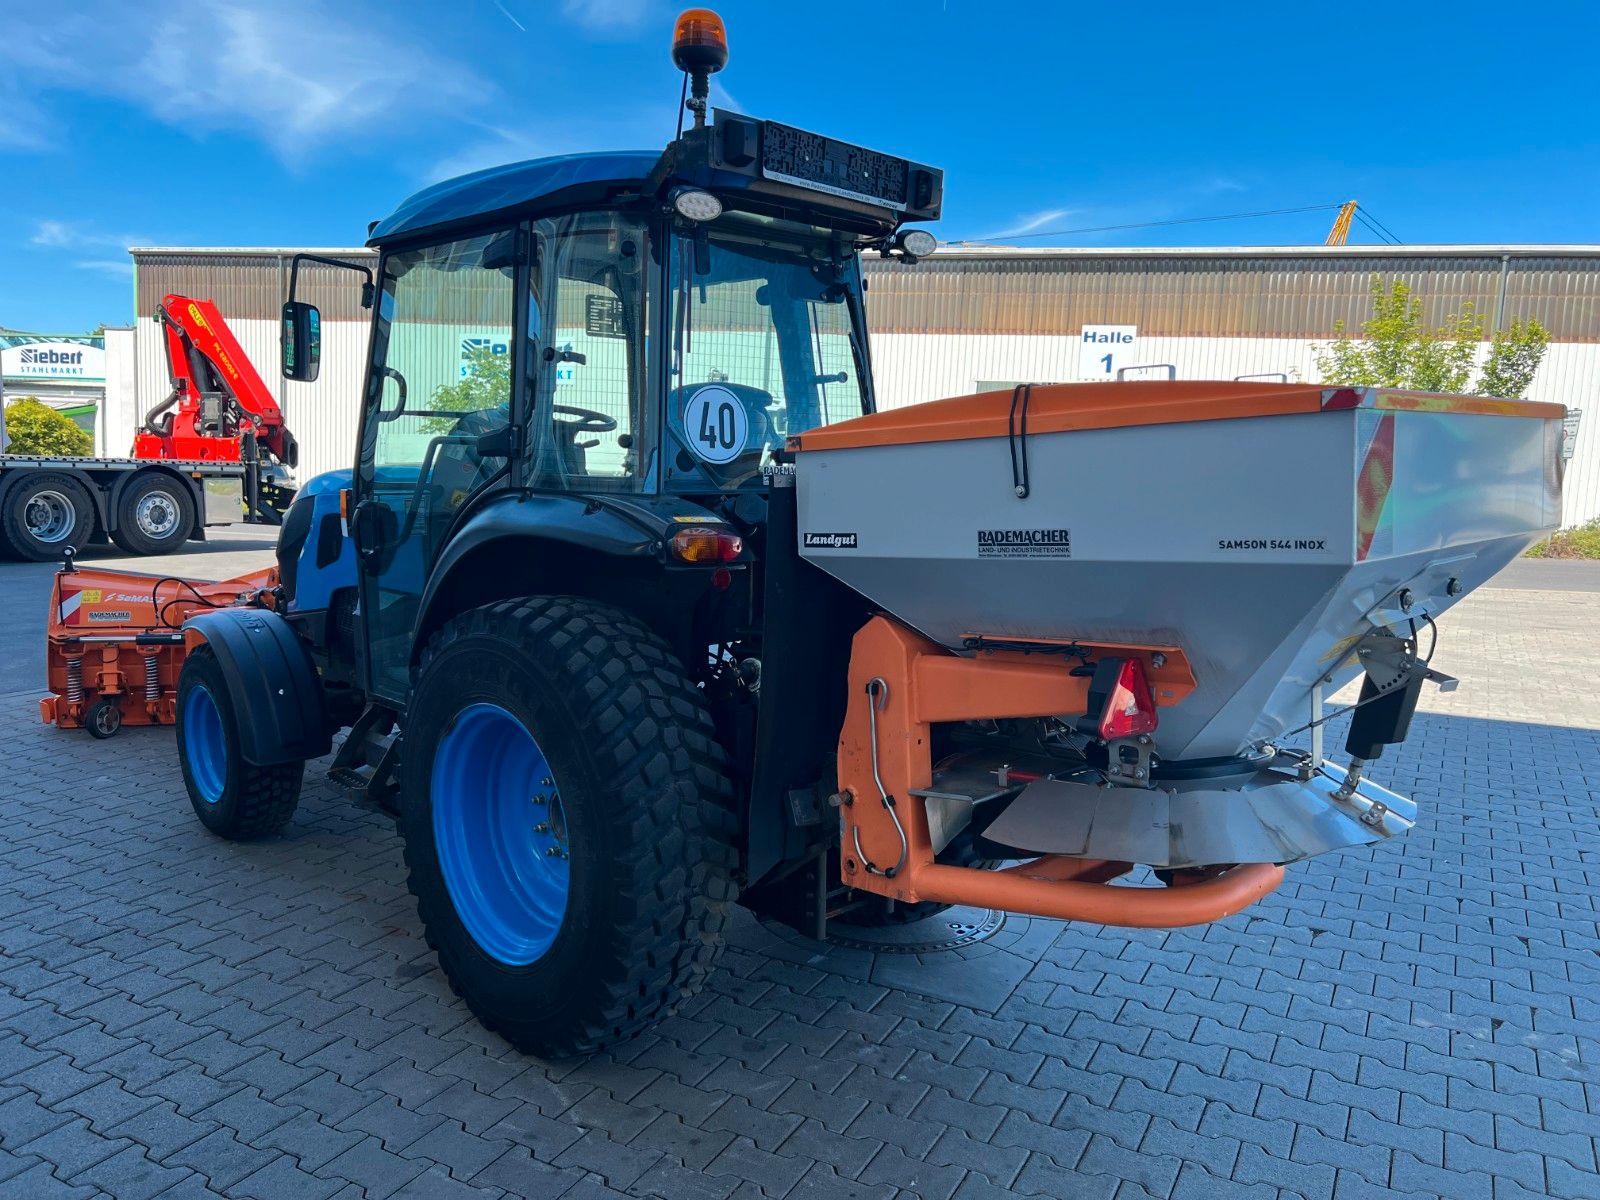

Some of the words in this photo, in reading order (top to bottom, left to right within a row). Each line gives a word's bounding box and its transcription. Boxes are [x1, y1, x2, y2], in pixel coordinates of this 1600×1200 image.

[1083, 332, 1134, 344] Halle
[20, 348, 83, 365] Siebert
[1100, 353, 1113, 374] 1
[20, 366, 84, 375] STAHLMARKT
[699, 401, 736, 450] 40
[763, 466, 797, 476] RADEMA
[805, 533, 856, 548] Landgut
[977, 529, 1070, 547] RADEMACHER
[977, 546, 997, 554] LAND-
[998, 546, 1011, 554] UND
[1011, 546, 1070, 554] INDUSTRIETECHNIK
[1218, 540, 1267, 550] SAMSON
[1270, 540, 1292, 550] 544
[1294, 540, 1325, 550] INOX
